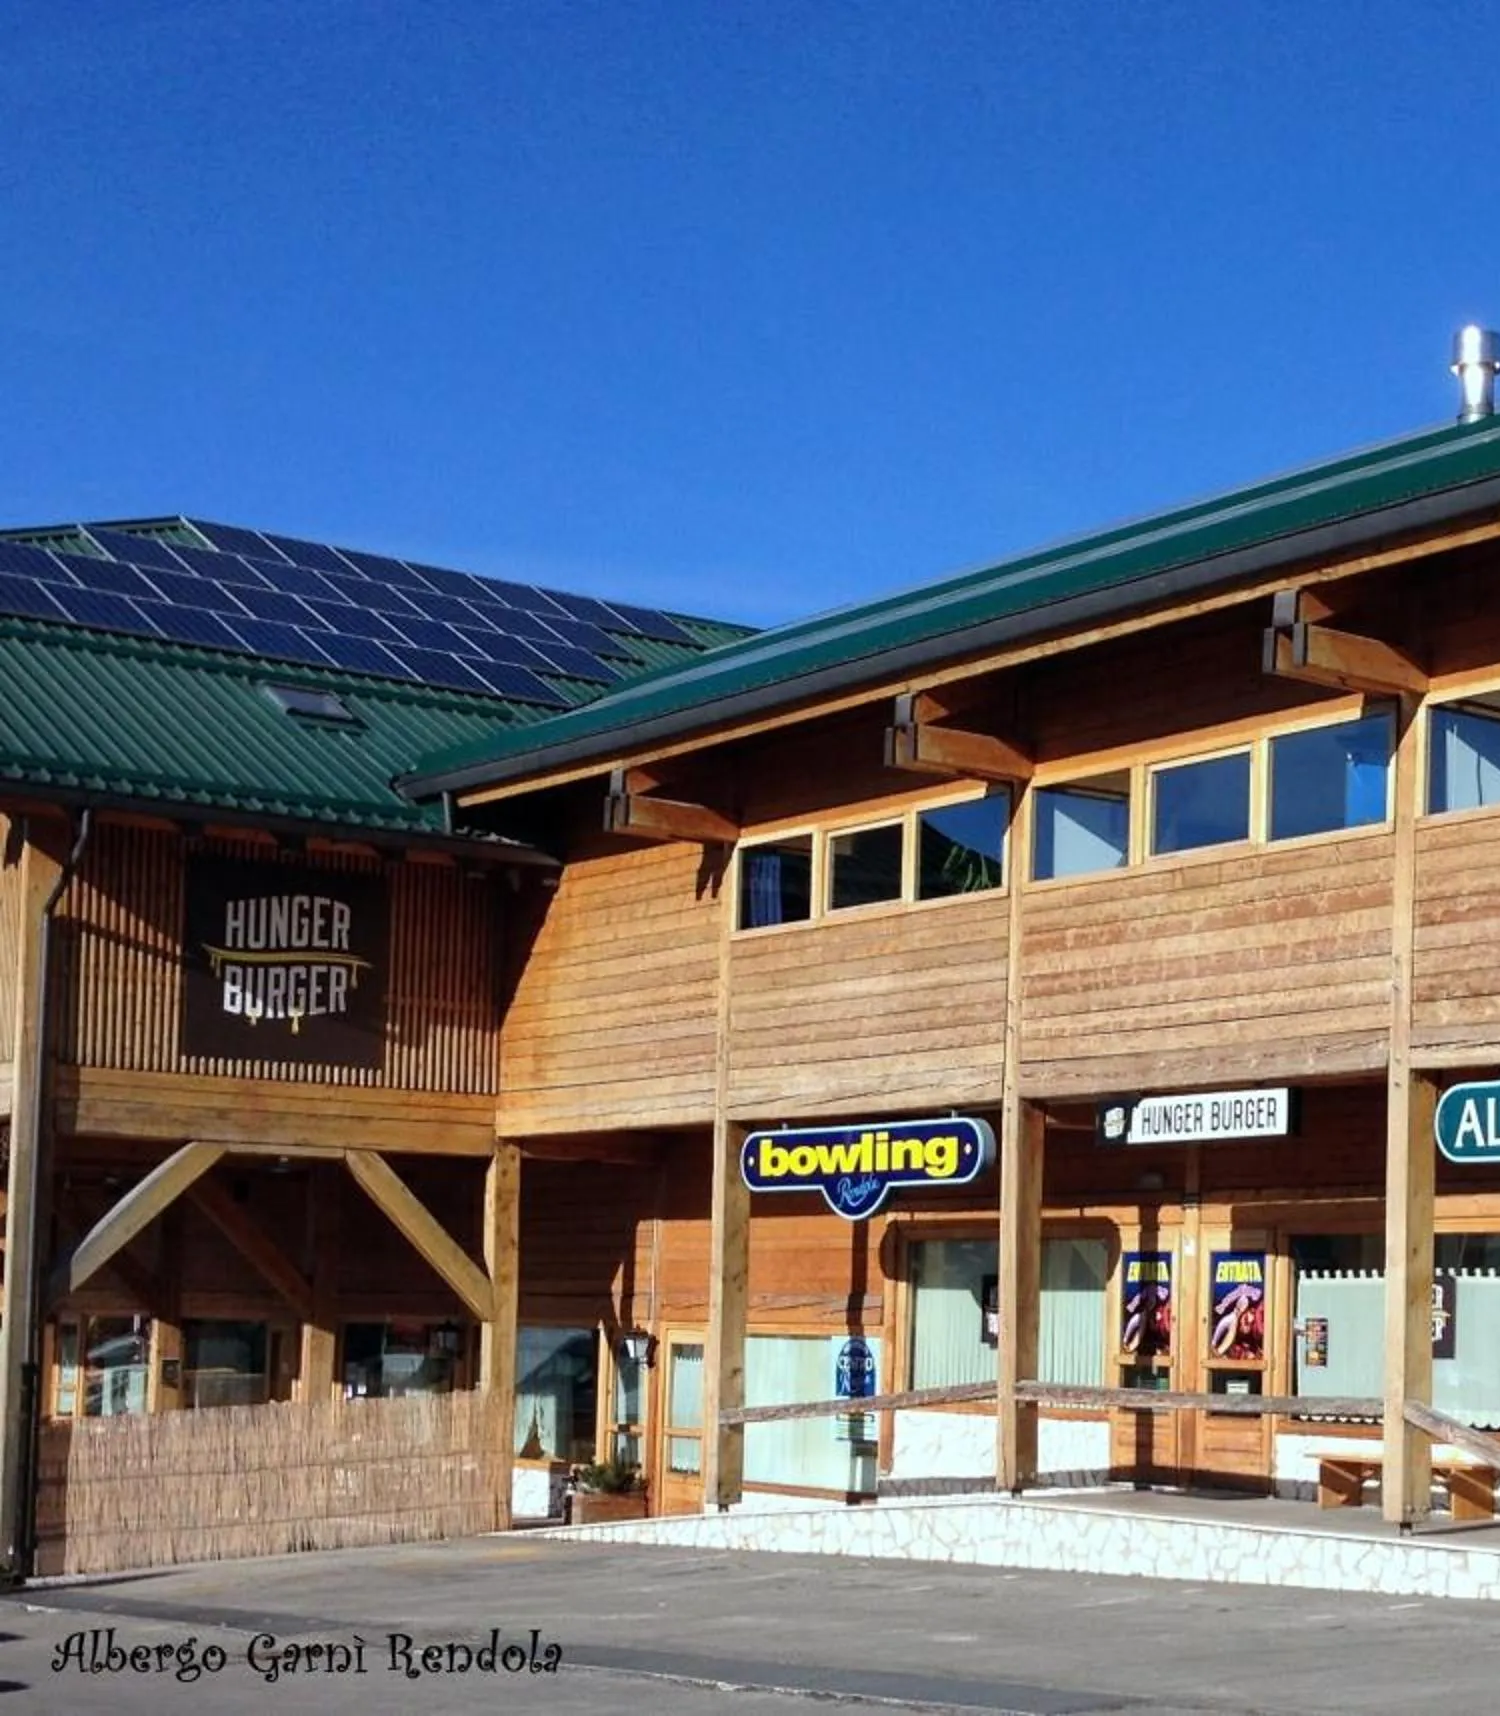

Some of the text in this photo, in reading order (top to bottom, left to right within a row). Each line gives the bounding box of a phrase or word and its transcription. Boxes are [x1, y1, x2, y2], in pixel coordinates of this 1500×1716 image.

[225, 894, 351, 950] HUNGER
[223, 964, 348, 1018] BURGER
[1141, 1101, 1204, 1136] HUNGER
[1210, 1097, 1277, 1131] BURGER
[759, 1131, 959, 1178] bowling
